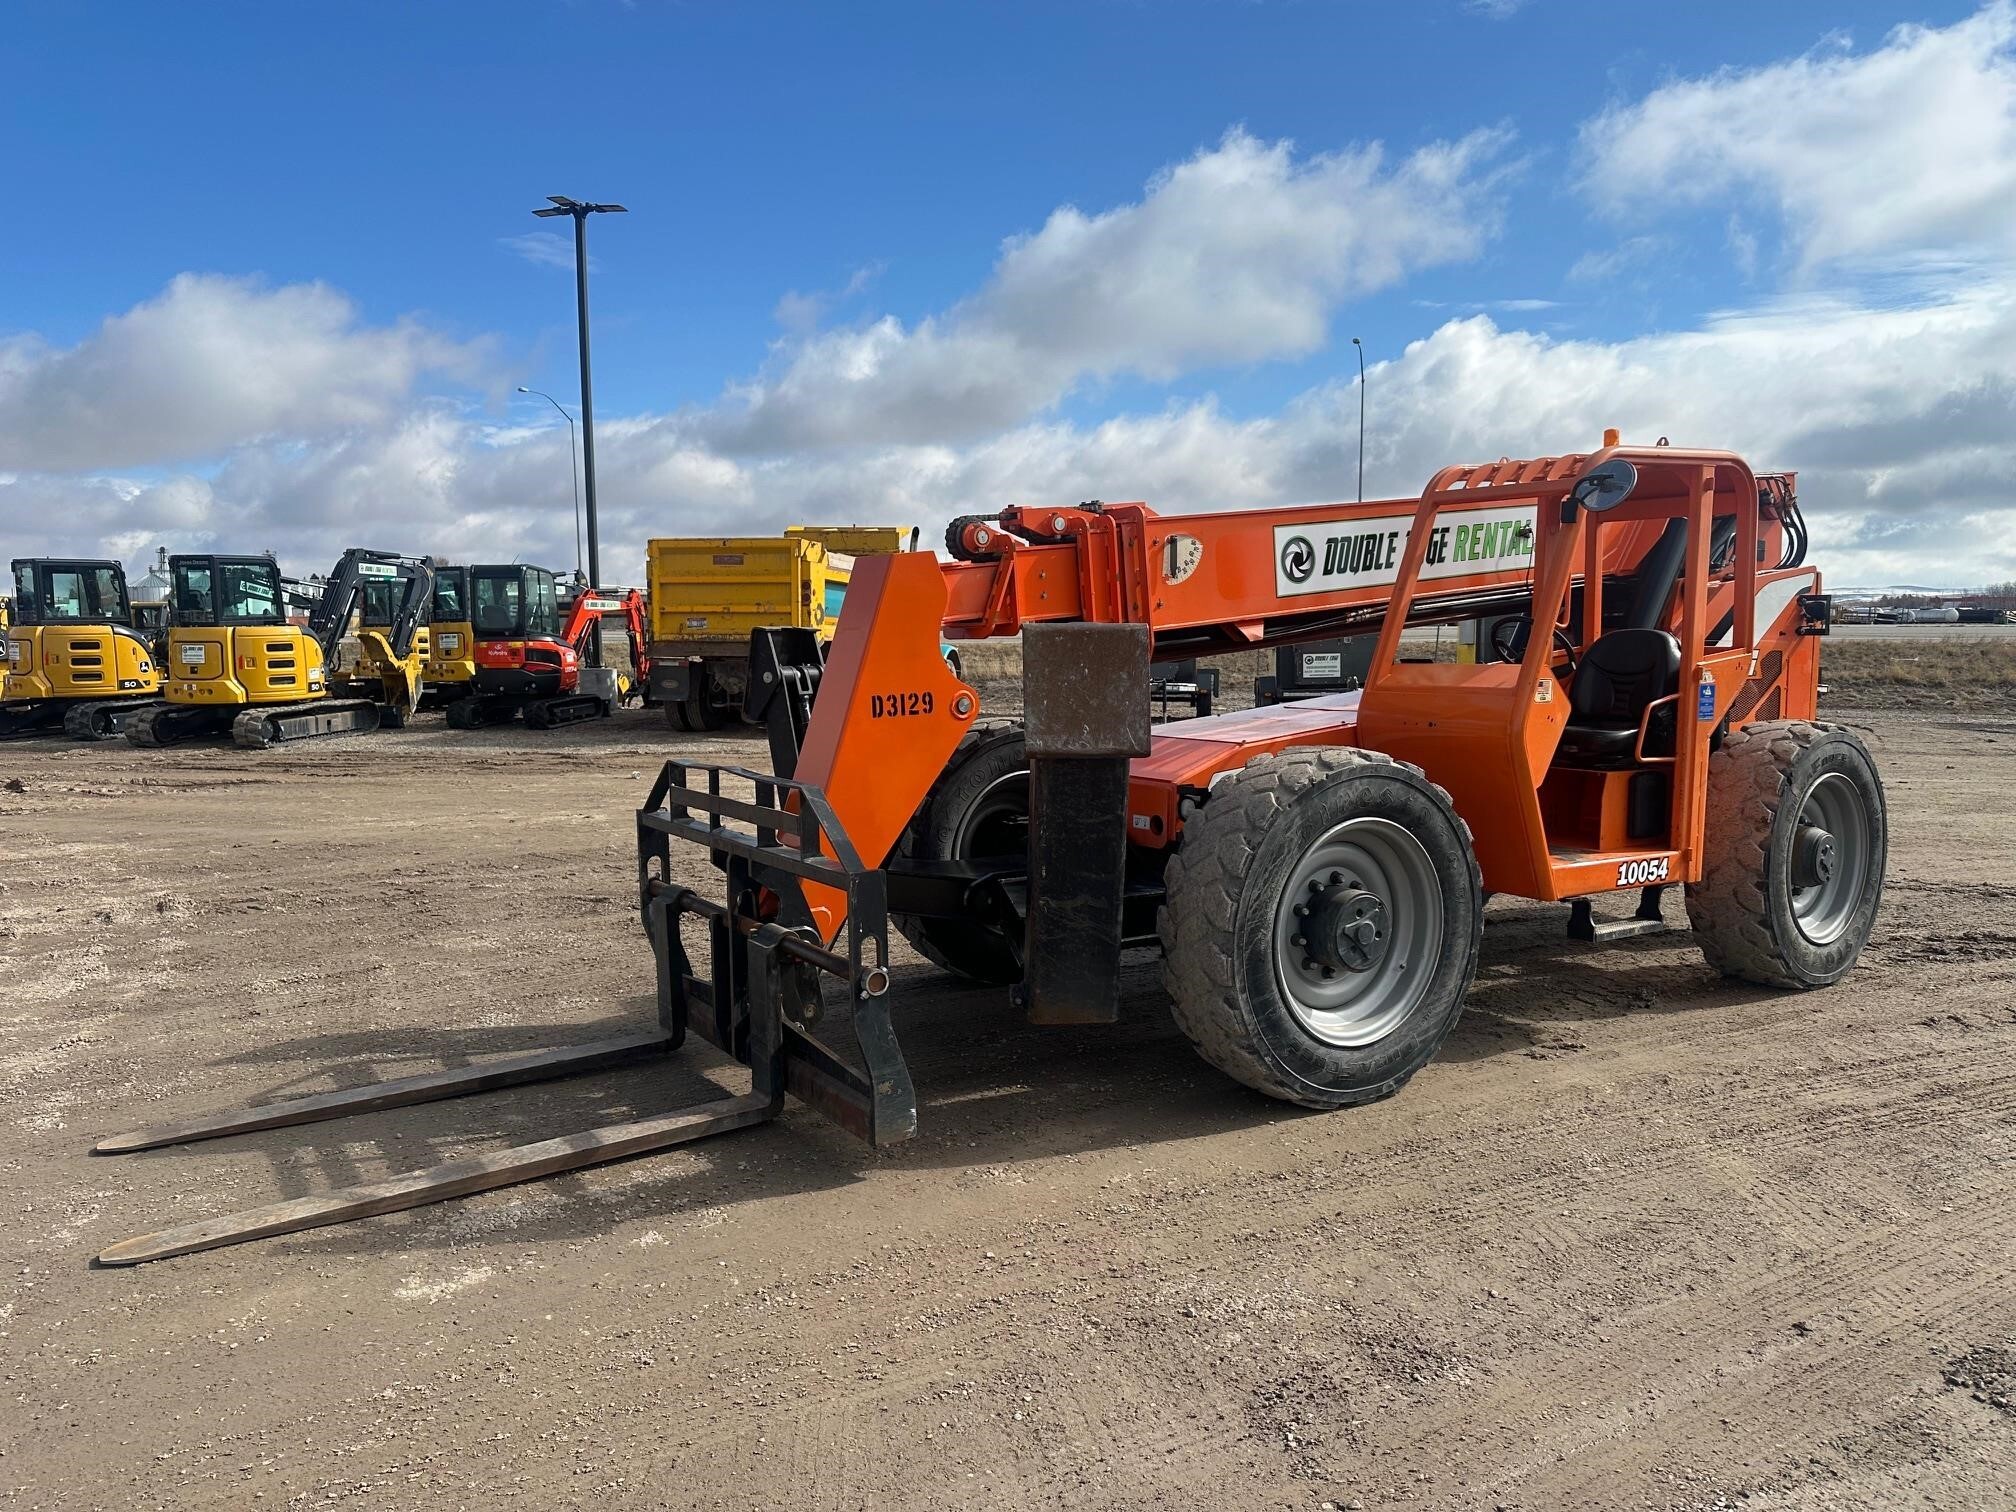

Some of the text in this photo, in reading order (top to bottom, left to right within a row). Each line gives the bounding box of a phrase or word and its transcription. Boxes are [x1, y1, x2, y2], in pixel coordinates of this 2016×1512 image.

[1322, 519, 1536, 576] DOUBLE GE RENTAL
[311, 683, 320, 691] 50
[871, 691, 934, 719] D3129
[1616, 857, 1669, 886] 10054
